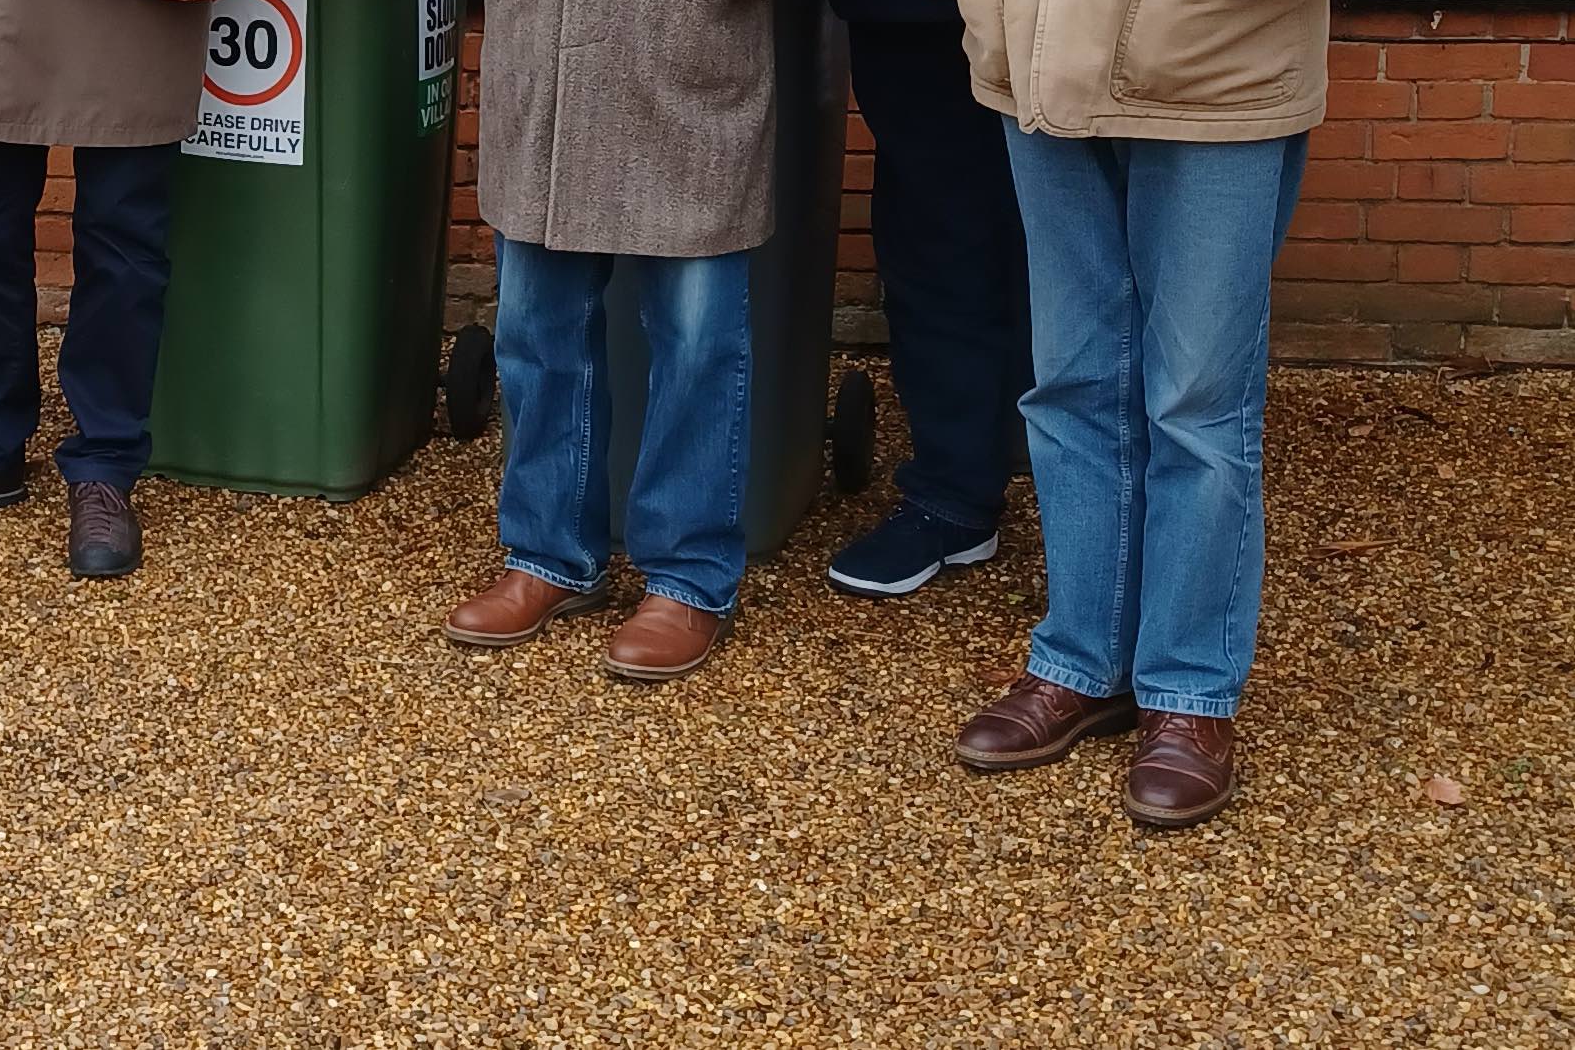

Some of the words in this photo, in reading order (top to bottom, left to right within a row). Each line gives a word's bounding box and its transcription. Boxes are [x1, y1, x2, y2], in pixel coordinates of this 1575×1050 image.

[209, 16, 278, 70] 30
[427, 82, 439, 105] IN
[251, 117, 301, 134] DRIVE
